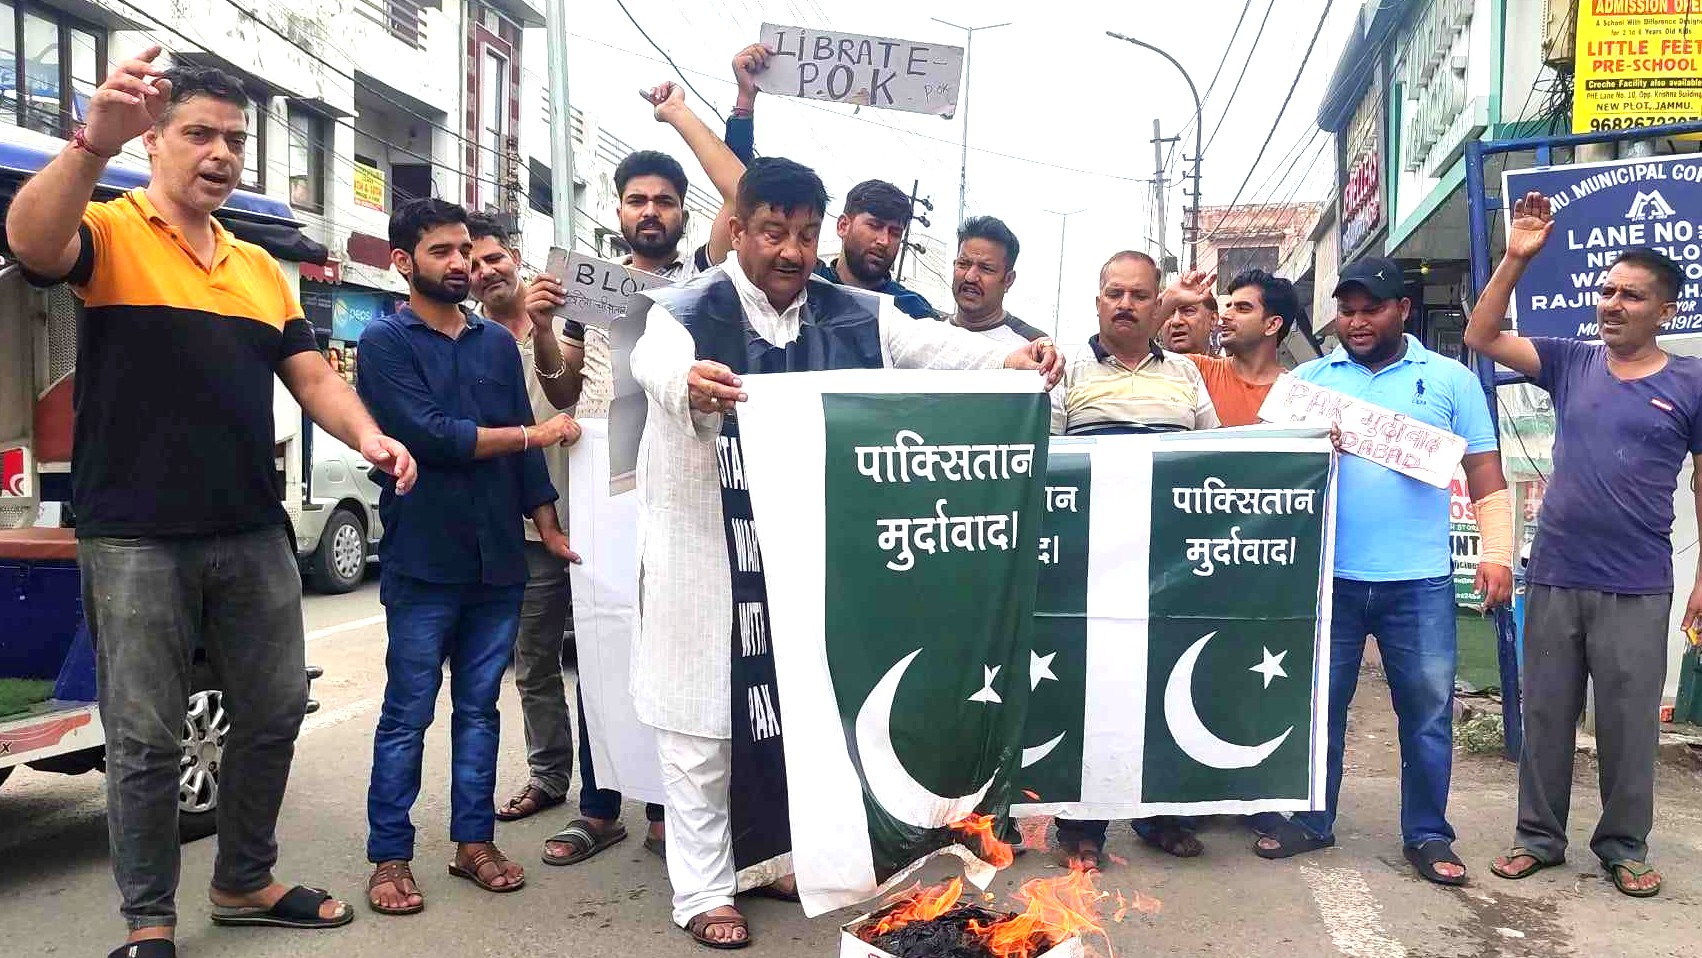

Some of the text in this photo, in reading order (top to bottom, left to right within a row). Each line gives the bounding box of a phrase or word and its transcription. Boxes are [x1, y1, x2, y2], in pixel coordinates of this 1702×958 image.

[1596, 0, 1702, 14] ADMISSION OPE
[1679, 27, 1692, 35] Kids
[1588, 39, 1702, 57] LITTLE FEET
[1592, 58, 1698, 73] PRE-SCHOOL
[1618, 79, 1648, 89] Facility
[1650, 79, 1666, 88] also
[1669, 78, 1702, 87] available
[1586, 92, 1599, 100] PHE
[1616, 91, 1626, 99] No.
[1654, 90, 1676, 98] Krishna
[1596, 102, 1620, 111] NEW
[1591, 116, 1699, 132] 968267
[1572, 164, 1667, 199] MUNICIPAL
[1568, 220, 1693, 250] LANE NO
[1588, 250, 1624, 268] NE
[575, 263, 646, 297] BLO
[1676, 300, 1697, 313] YOR
[1577, 322, 1600, 338] MO
[1284, 384, 1354, 424] PAK
[748, 684, 781, 742] PAK
